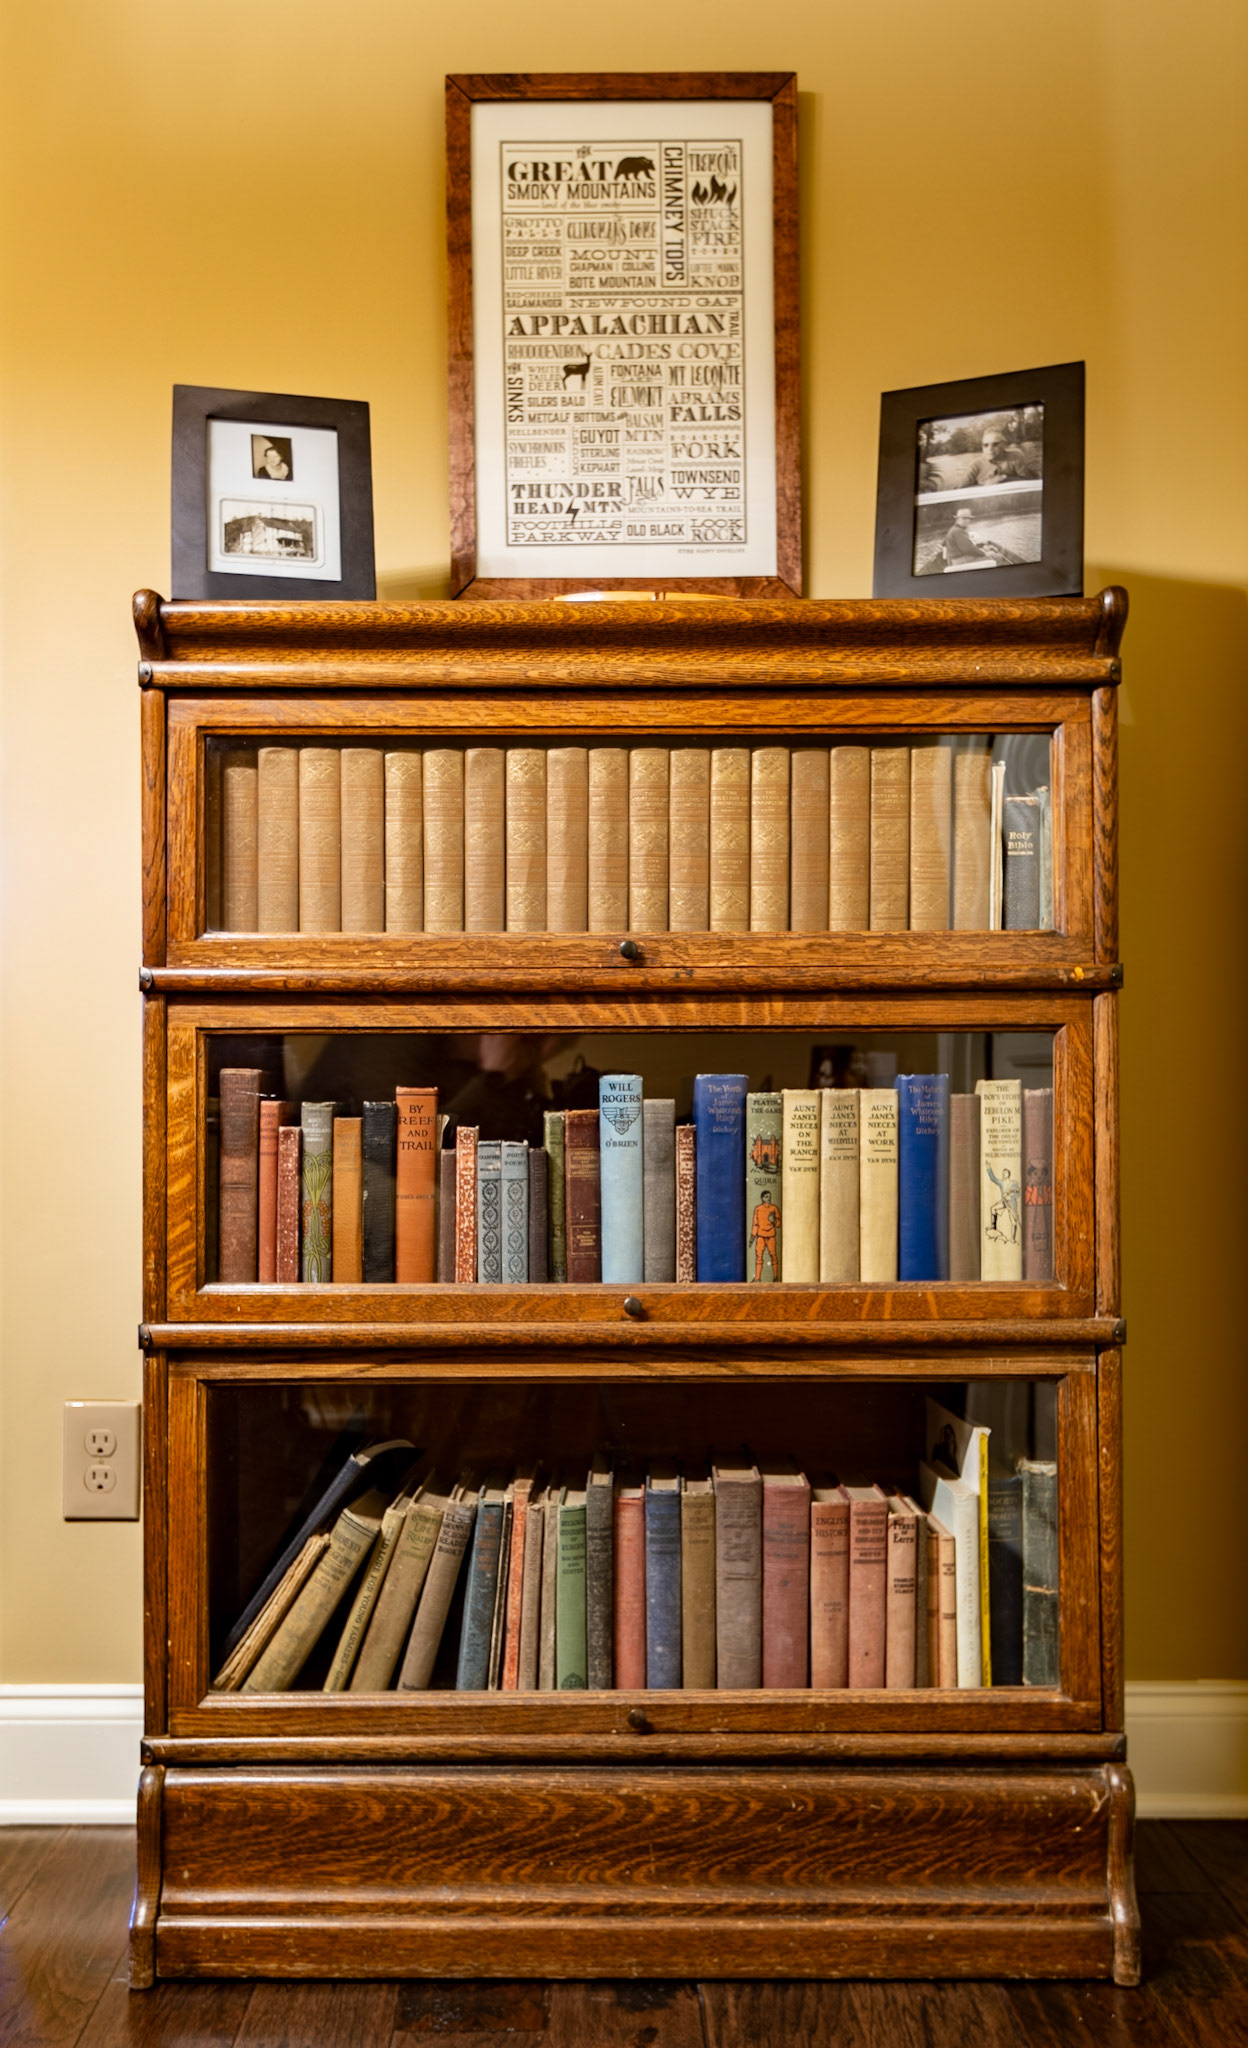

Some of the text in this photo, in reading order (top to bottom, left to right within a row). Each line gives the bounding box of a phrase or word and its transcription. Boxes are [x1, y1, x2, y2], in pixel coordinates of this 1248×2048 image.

[508, 161, 613, 182] GREAT
[508, 182, 656, 200] SMOKY MOUNTAINS
[664, 147, 685, 281] CHIMNEY TOPS
[690, 208, 739, 220] SHUCK
[505, 218, 563, 228] GROTTO
[690, 220, 739, 231] STACK
[691, 232, 740, 246] FIRE
[506, 246, 562, 257] DEEP CREEK
[570, 250, 658, 260] MOUNT
[570, 262, 656, 272] CHAPMAN COLLINS
[506, 266, 562, 280] LITTLE RIVER
[570, 276, 656, 288] BOTE MOUNTAIN
[691, 275, 740, 288] KNOB
[506, 299, 562, 308] SALAMANDER
[568, 297, 739, 308] NEWFOUND GAP
[508, 313, 726, 336] APPALACHIAN
[730, 311, 740, 338] TRAIL
[596, 343, 740, 360] CADES COVE
[611, 364, 662, 377] FONTANA
[669, 366, 686, 386] MT
[528, 382, 562, 392] DEER
[508, 377, 524, 422] SINKS
[528, 396, 585, 407] SILERS BALD
[668, 392, 740, 405] ABRAMS
[528, 412, 616, 423] METCALF BOTTOMS
[670, 406, 741, 422] FALLS
[626, 413, 664, 428] BALSAM
[580, 430, 620, 444] GUYOT
[625, 430, 664, 442] MTN
[580, 448, 620, 458] STERLING
[670, 442, 740, 458] FORK
[509, 456, 548, 468] FIREFLIES
[580, 463, 620, 472] KEPHART
[670, 470, 740, 484] TOWNSEND
[511, 482, 622, 498] THUNDER
[670, 487, 740, 500] WYE
[514, 502, 622, 514] HEAD MTN
[512, 520, 622, 530] FOOTHILLS
[690, 518, 742, 528] LOOK
[626, 524, 685, 536] OLD BLACK
[692, 528, 742, 541] ROCK
[512, 532, 622, 542] PARKWAY
[1008, 832, 1032, 842] Holy
[1008, 841, 1034, 850] Bible
[608, 1083, 634, 1092] WILL
[708, 1085, 722, 1093] The
[908, 1085, 920, 1094] The
[602, 1094, 640, 1104] ROGERS
[409, 1105, 424, 1114] BY
[984, 1107, 1014, 1115] ZEBULON
[399, 1116, 434, 1126] REEF
[715, 1115, 736, 1124] Riley
[830, 1112, 856, 1120] JANE'S
[920, 1116, 938, 1126] Riley
[992, 1116, 1014, 1124] PIKE
[790, 1122, 818, 1130] NIECES
[400, 1142, 434, 1150] TRAIL
[606, 1138, 638, 1148] O'BRIEN
[754, 1178, 777, 1186] QUIRK
[371, 1550, 386, 1573] LORE
[365, 1575, 377, 1592] FOR
[353, 1594, 371, 1624] YOUNG
